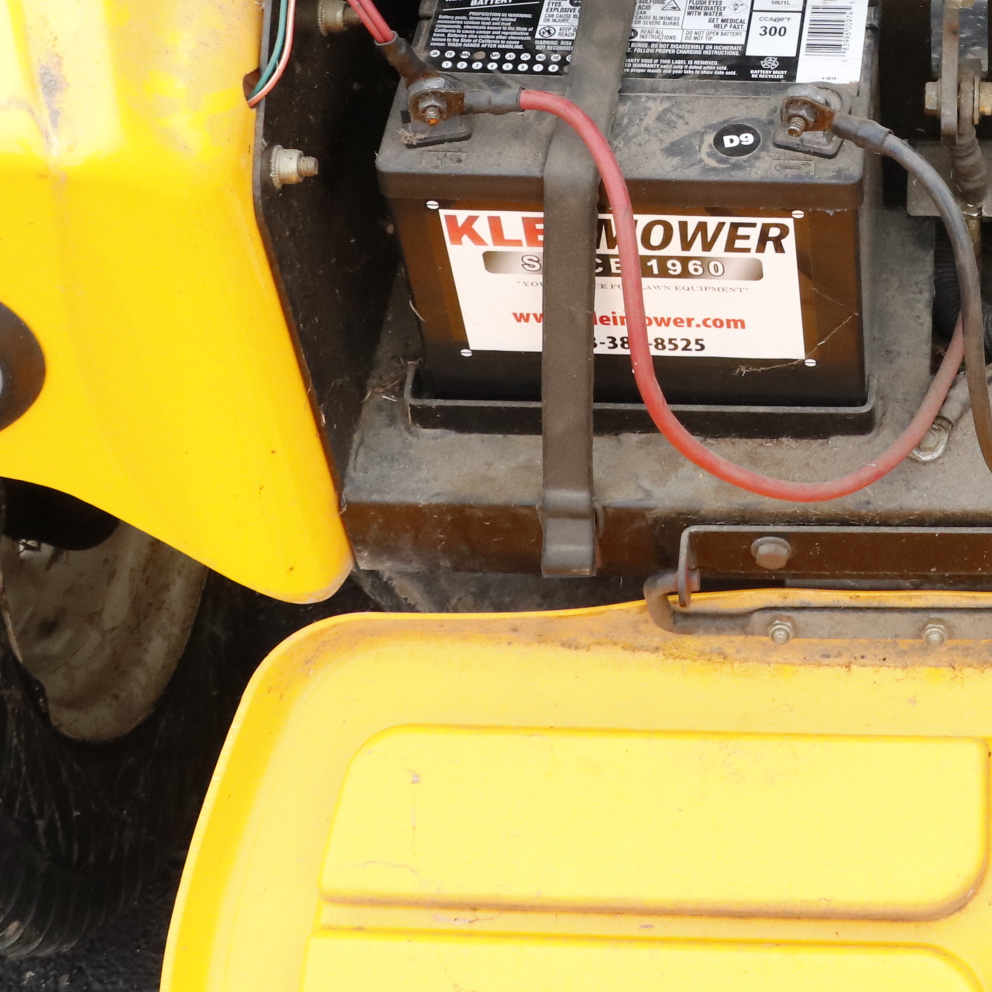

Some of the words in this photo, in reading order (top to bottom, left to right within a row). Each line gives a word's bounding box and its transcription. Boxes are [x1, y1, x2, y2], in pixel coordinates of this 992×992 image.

[759, 26, 787, 37] 300
[723, 133, 754, 148] D9
[646, 258, 725, 277] 1960
